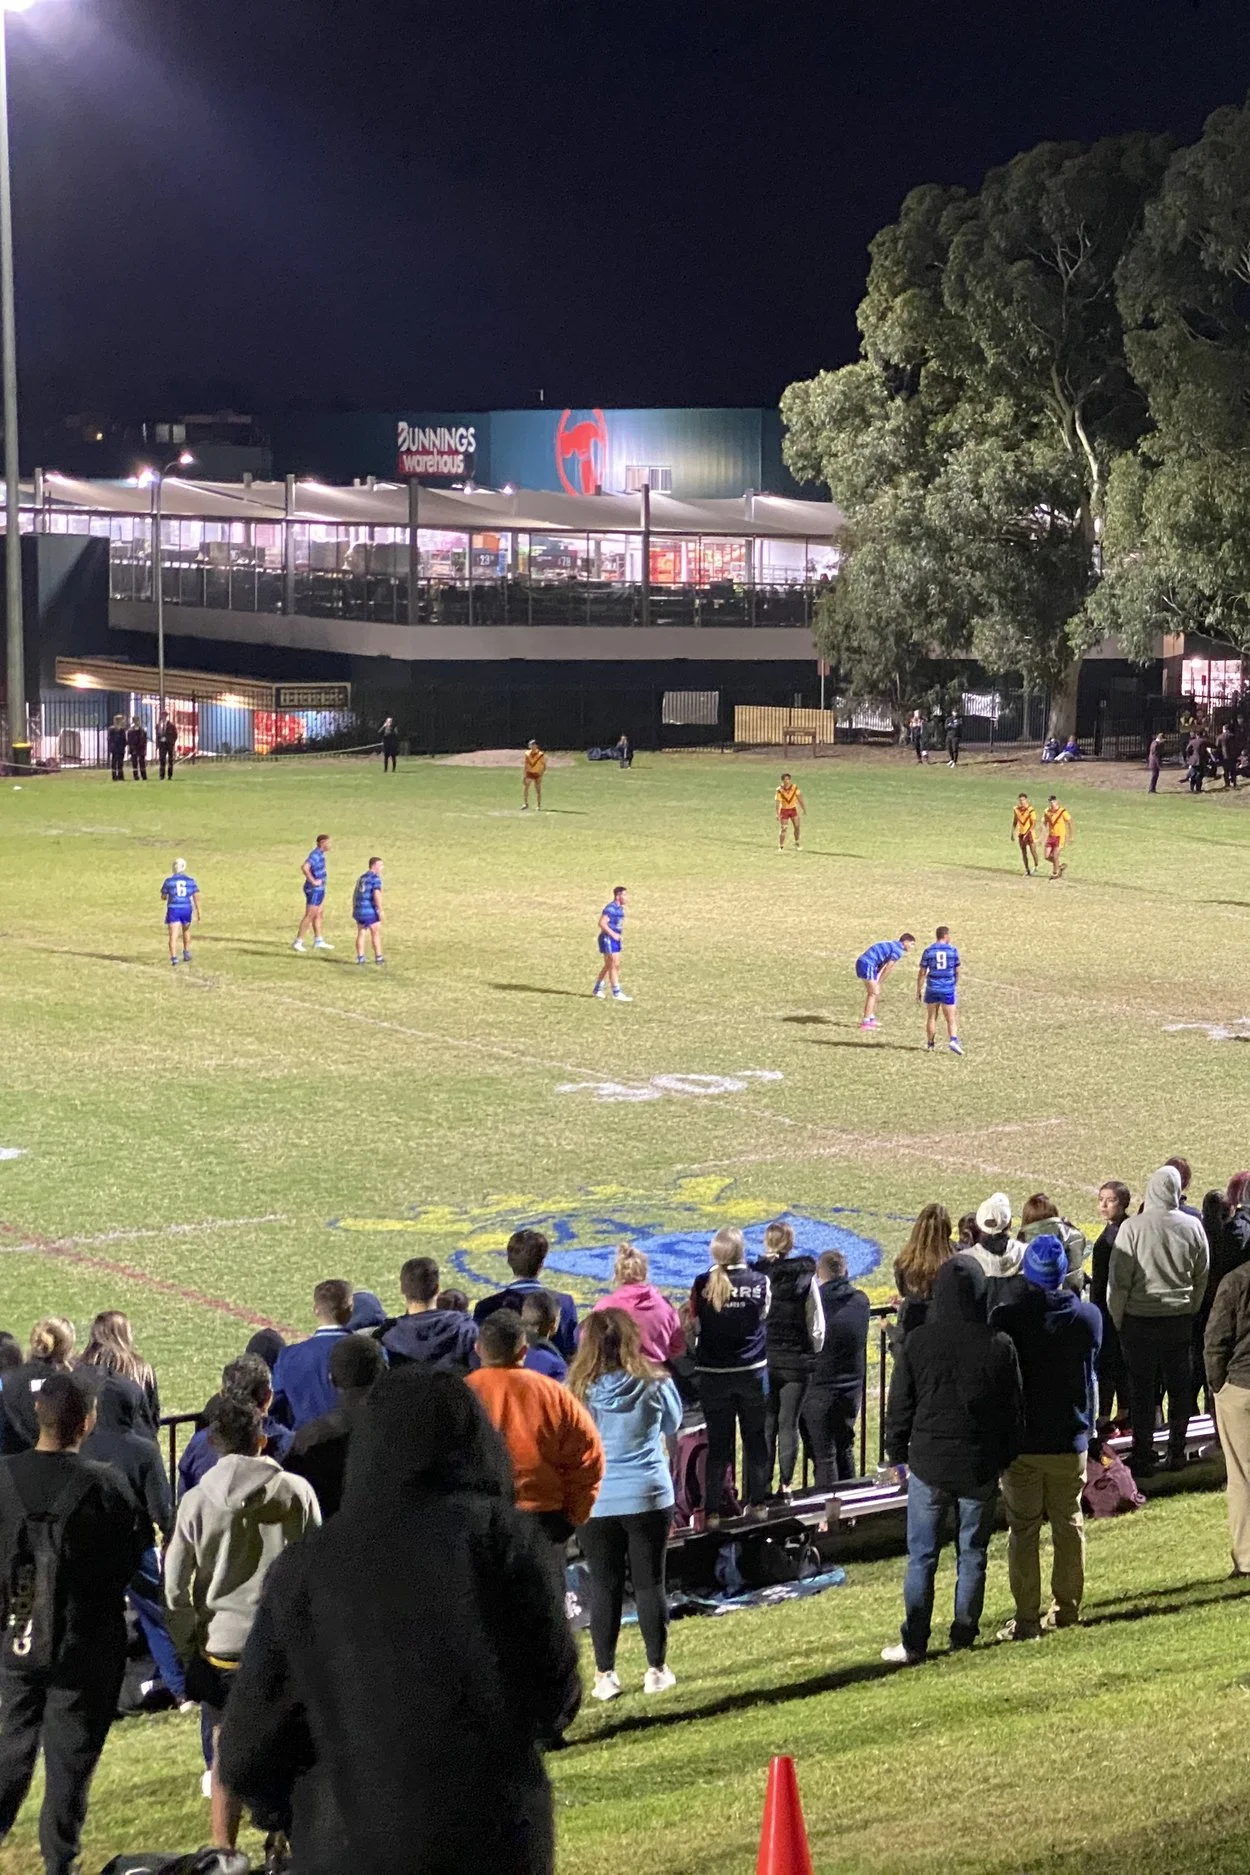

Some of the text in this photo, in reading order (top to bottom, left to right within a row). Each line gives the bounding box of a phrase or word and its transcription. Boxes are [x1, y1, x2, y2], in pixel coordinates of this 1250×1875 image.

[397, 421, 477, 453] BUNNINGS
[402, 447, 465, 474] warehous
[176, 880, 187, 897] 6
[936, 951, 947, 970] 9
